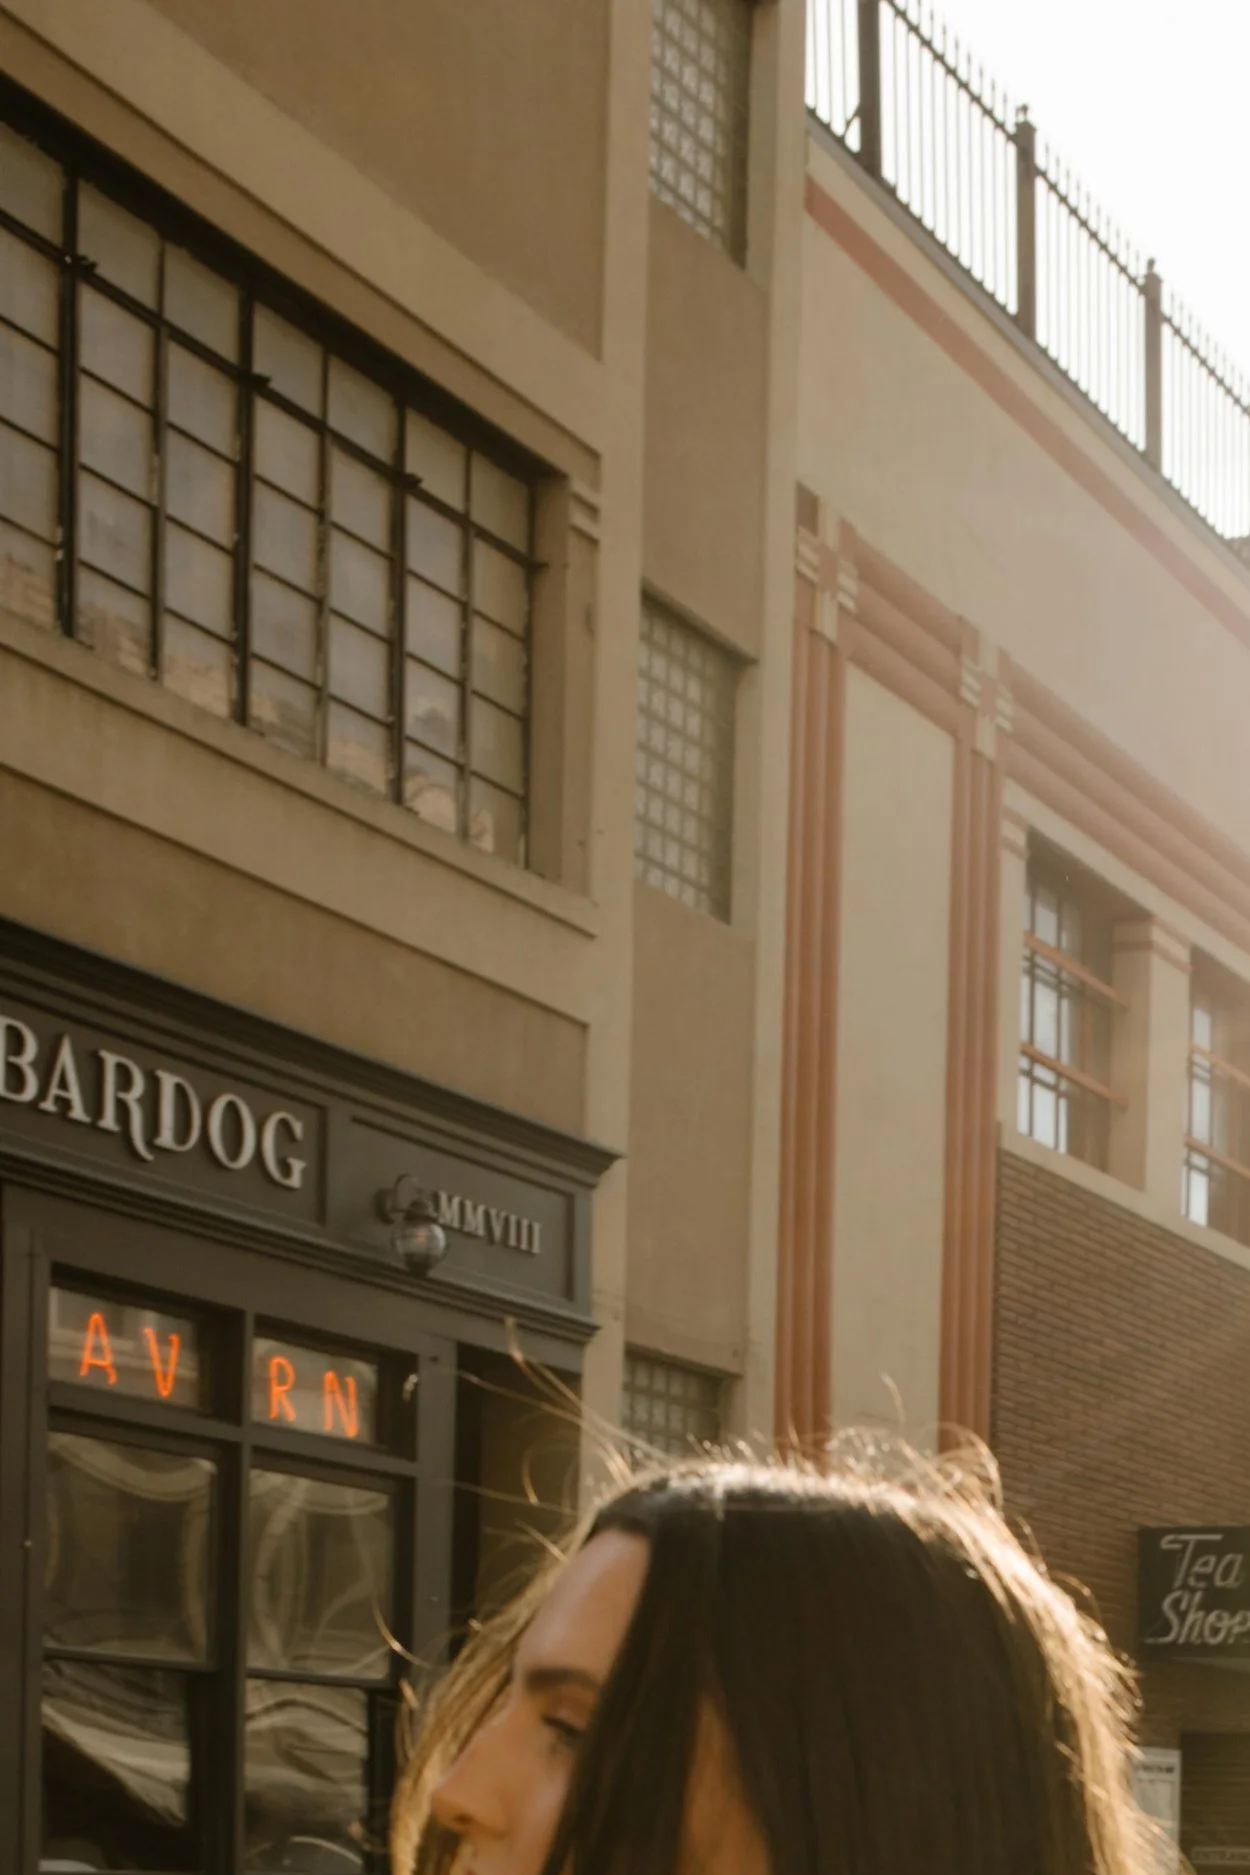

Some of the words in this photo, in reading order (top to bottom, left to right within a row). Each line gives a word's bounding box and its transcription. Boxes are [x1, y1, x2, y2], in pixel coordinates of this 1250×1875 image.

[0, 1015, 306, 1188] BARDOG
[437, 1190, 541, 1254] MMVIII
[79, 1312, 358, 1438] AVRN
[1160, 1534, 1244, 1590] Tea
